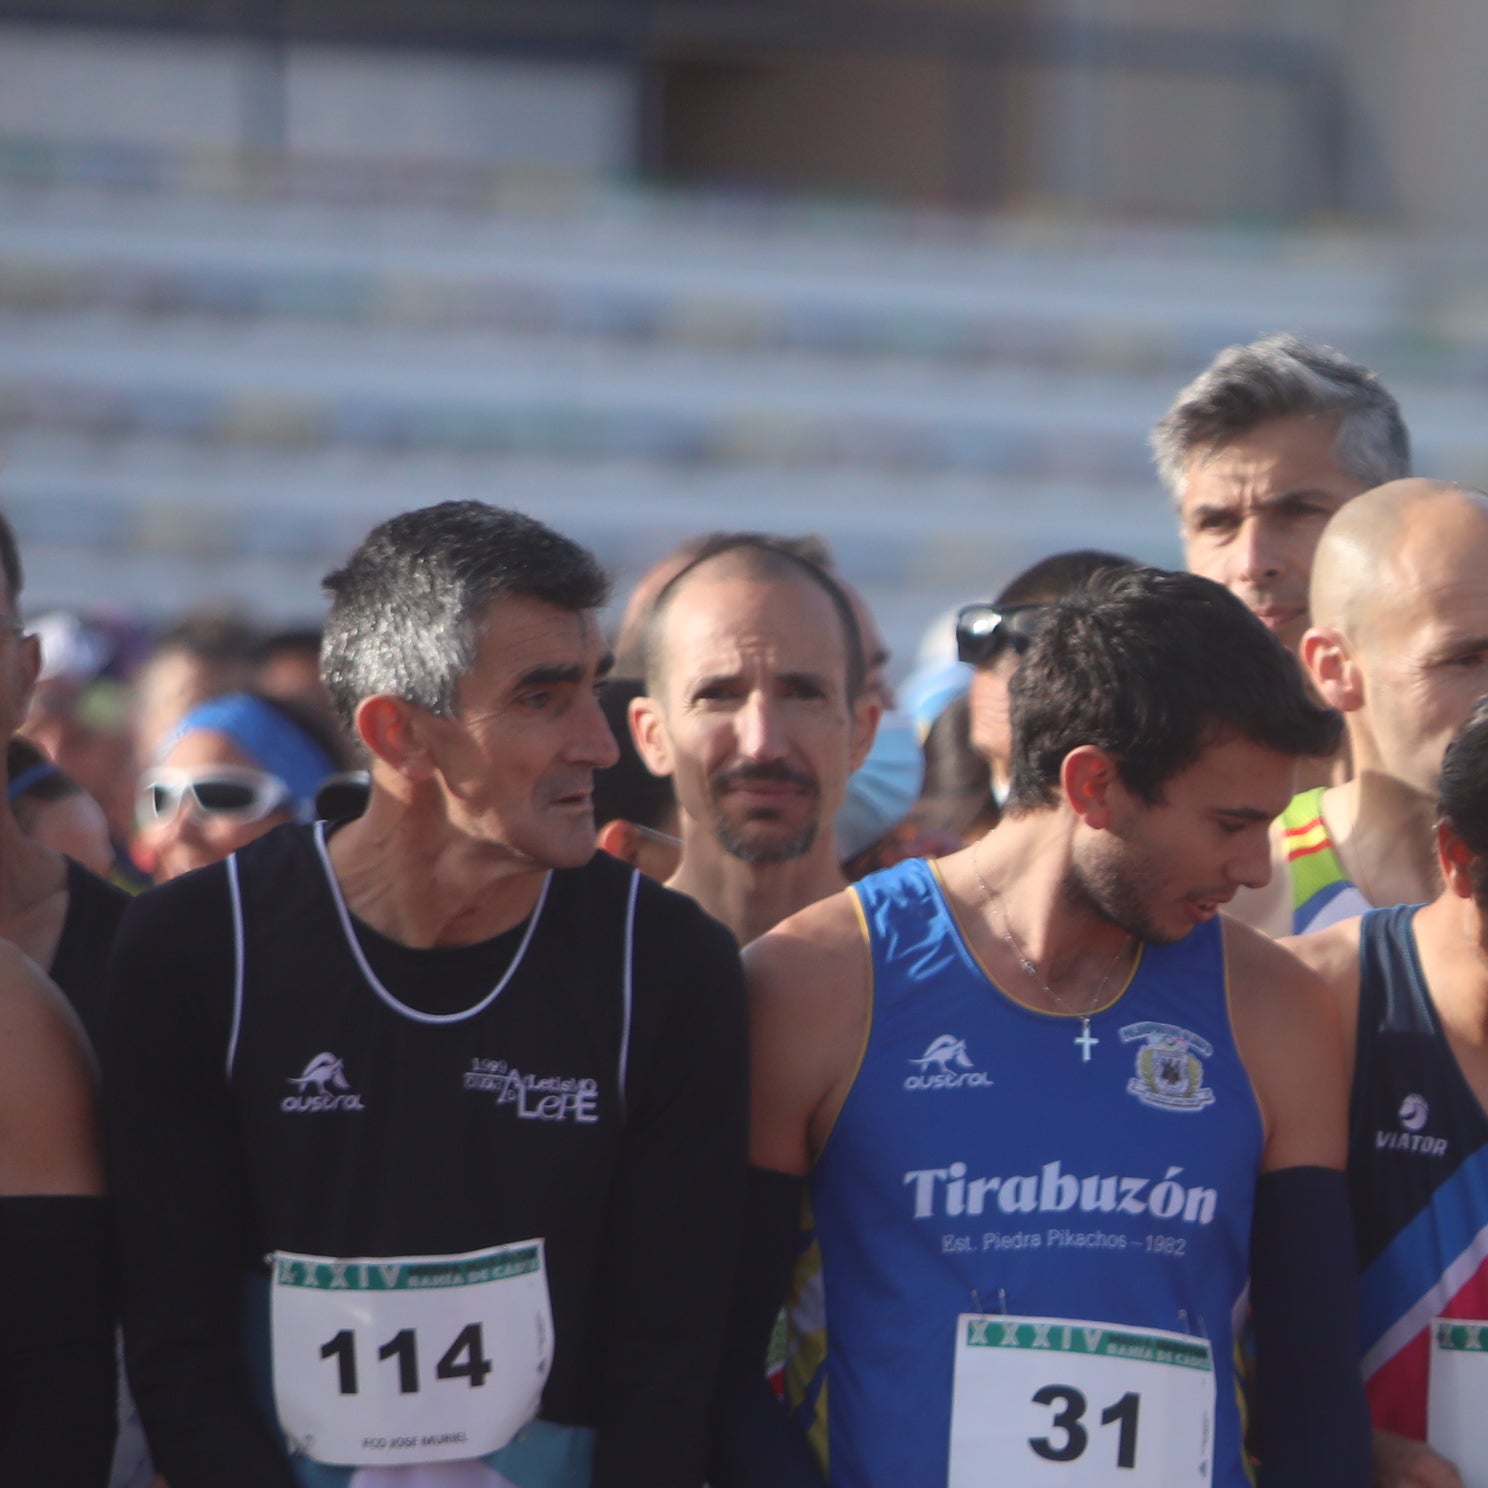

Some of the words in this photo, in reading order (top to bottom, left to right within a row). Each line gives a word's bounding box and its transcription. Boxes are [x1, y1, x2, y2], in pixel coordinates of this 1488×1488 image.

[1374, 1131, 1449, 1157] VIATOR
[904, 1160, 1218, 1225] Tirabuzón
[942, 1233, 978, 1253] Est.
[982, 1231, 1042, 1251] Piedra
[1046, 1229, 1127, 1249] Pikachos
[318, 1321, 494, 1395] 114
[1027, 1383, 1142, 1470] 31
